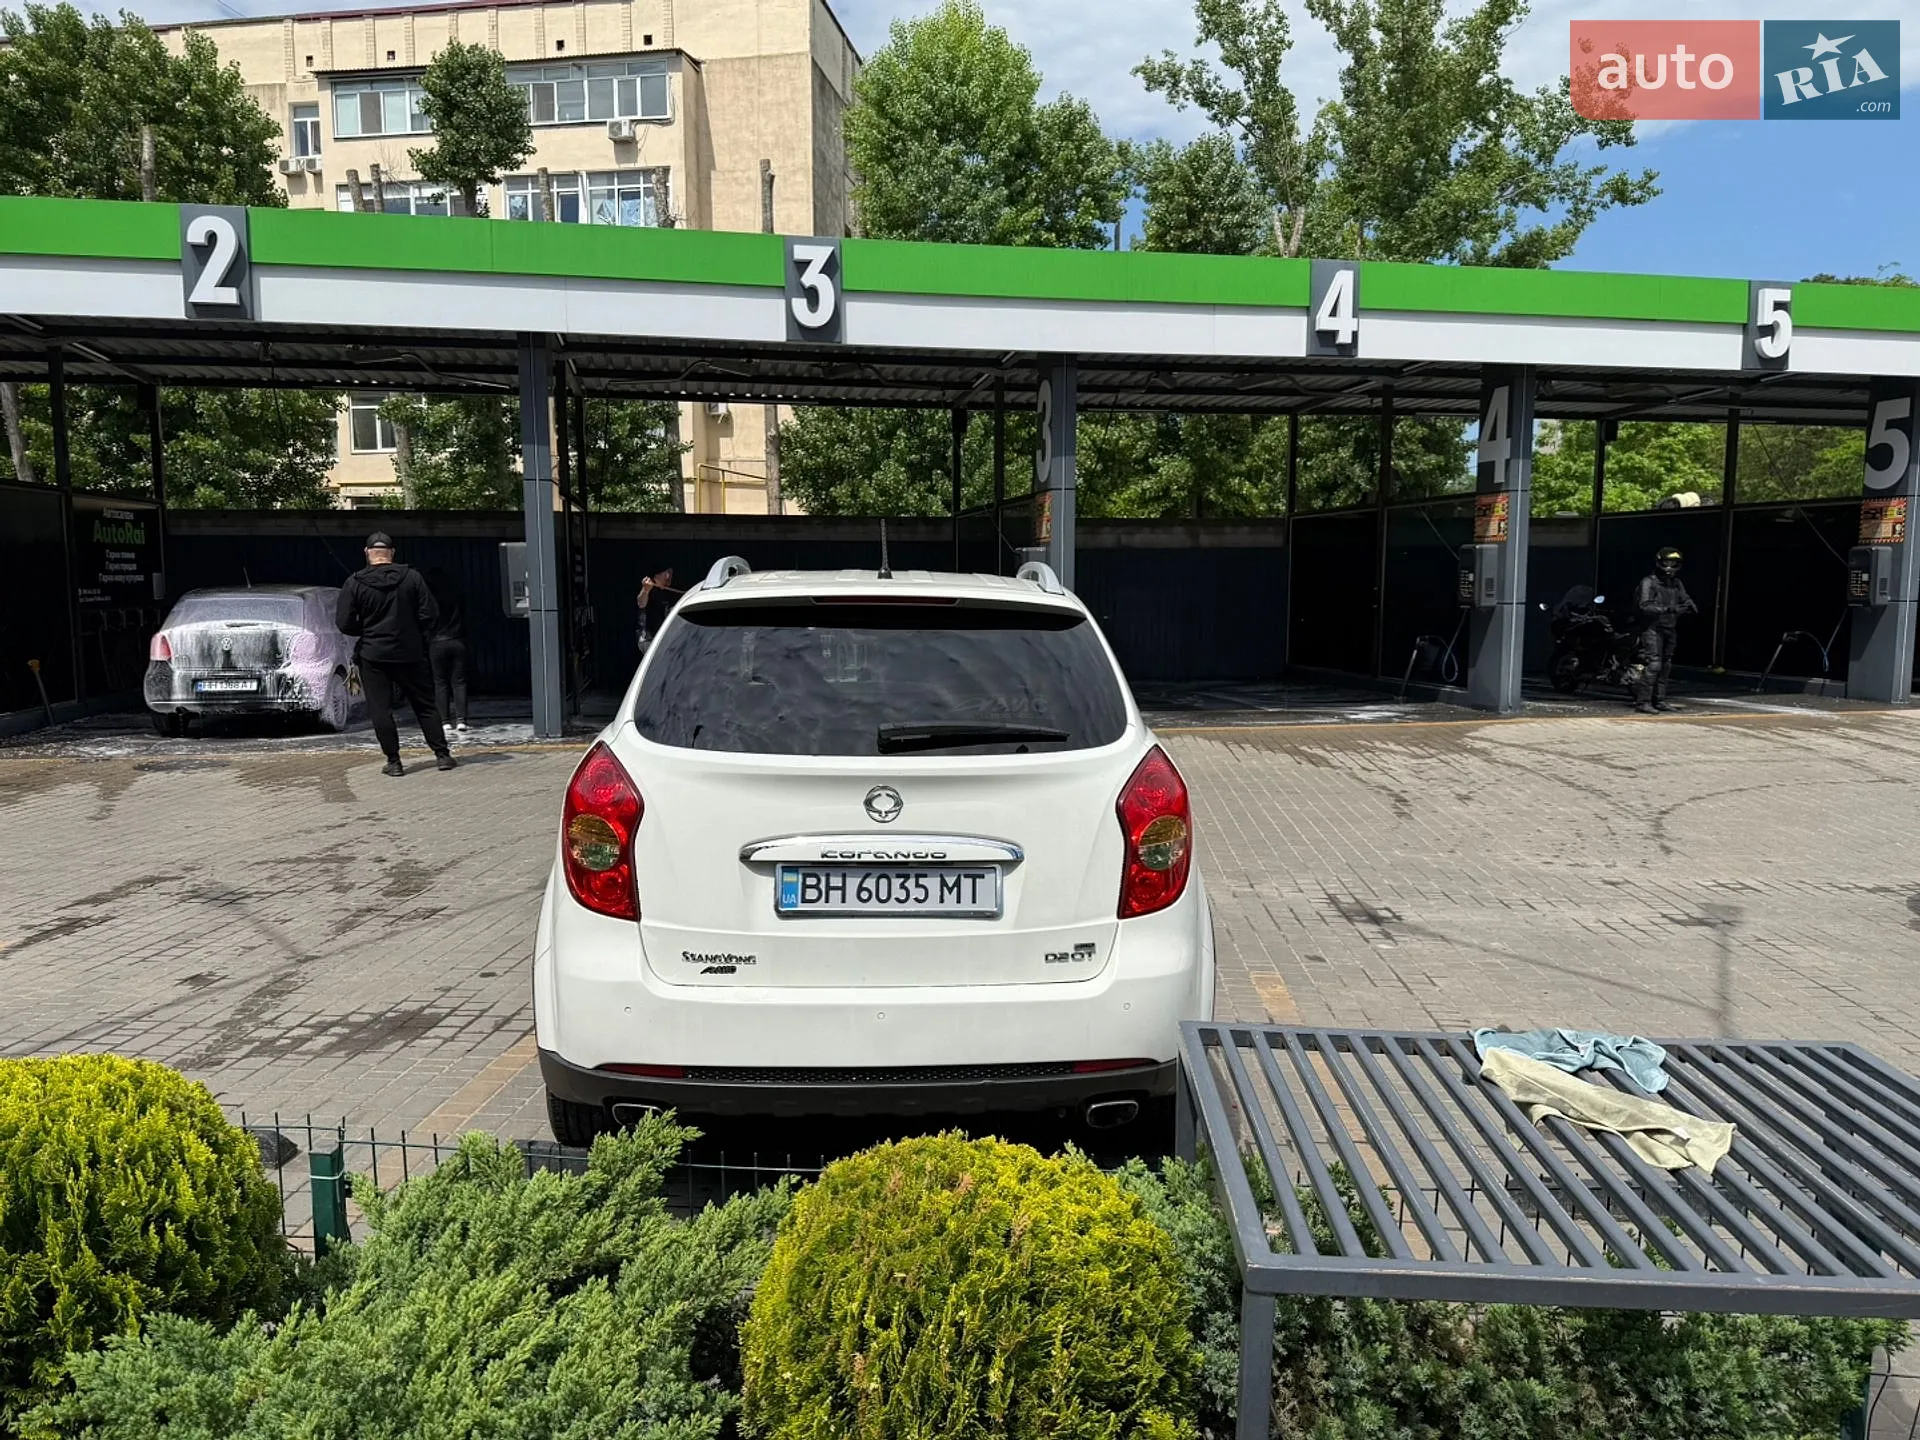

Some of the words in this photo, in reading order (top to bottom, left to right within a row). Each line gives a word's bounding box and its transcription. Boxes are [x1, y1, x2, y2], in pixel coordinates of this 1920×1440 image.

[186, 215, 240, 306] 2
[791, 244, 835, 329] 3
[1315, 269, 1358, 346] 4
[1754, 288, 1793, 359] 5
[1036, 379, 1052, 483] 3
[1478, 386, 1511, 484] 4
[1864, 397, 1911, 490] 5
[92, 519, 146, 545] AutoRai
[782, 894, 797, 905] UA
[800, 873, 847, 904] BH
[856, 873, 929, 905] 6035
[938, 873, 985, 905] MT
